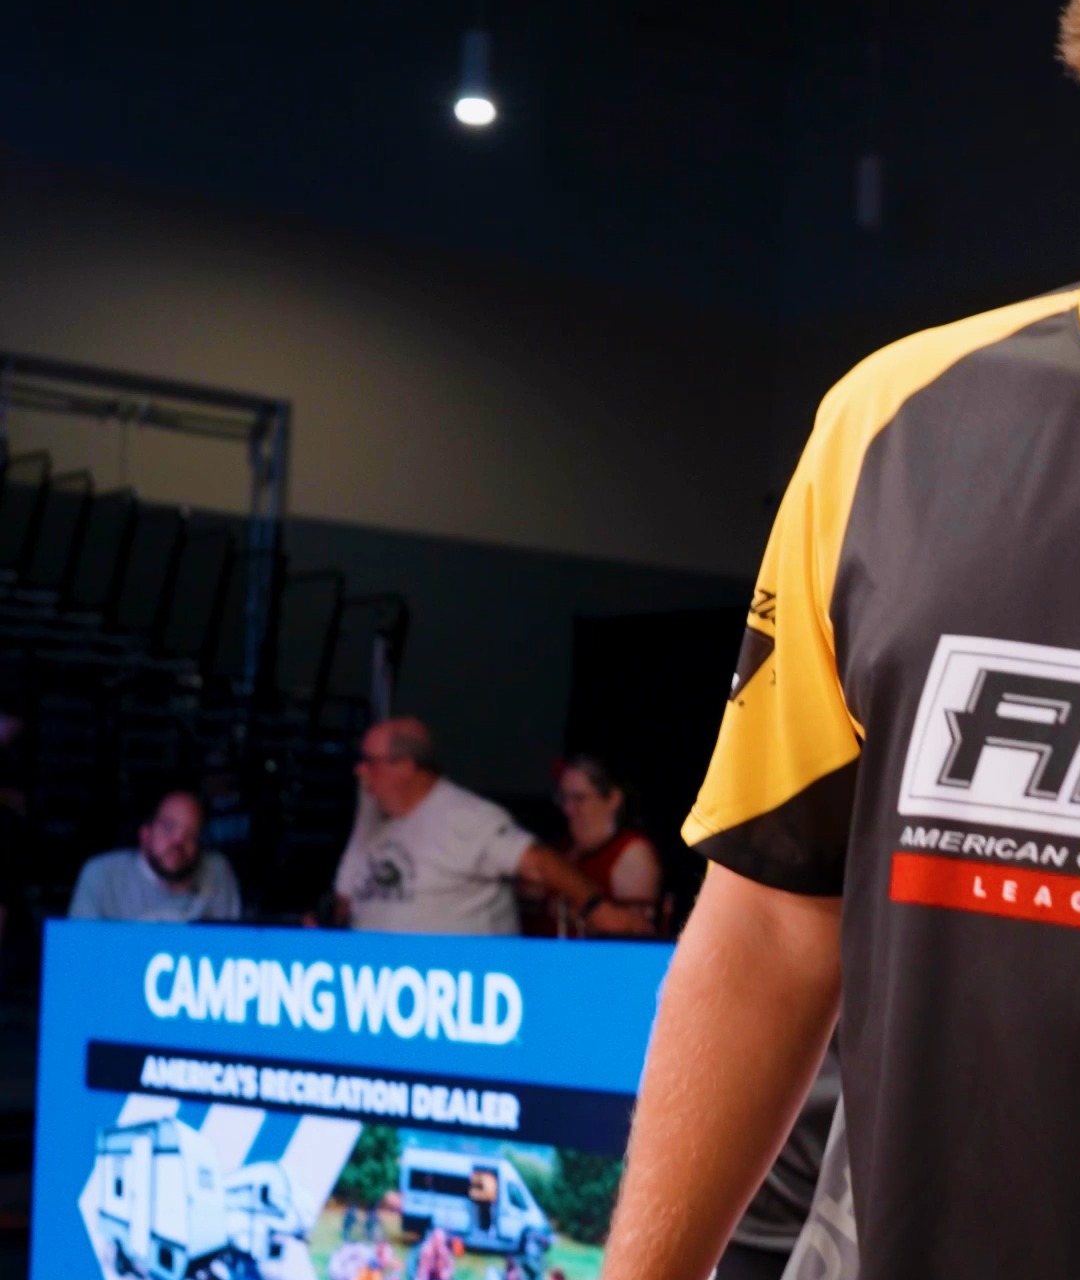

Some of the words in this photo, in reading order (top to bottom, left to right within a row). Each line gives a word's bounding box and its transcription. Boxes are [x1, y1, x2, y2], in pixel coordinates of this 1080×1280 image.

[900, 826, 1069, 867] AMERICAN
[144, 952, 336, 1032] CAMPING
[340, 964, 523, 1045] WORLD
[140, 1054, 258, 1100] AMERICA'S
[260, 1067, 409, 1116] RECREATION
[411, 1083, 521, 1131] DEALER
